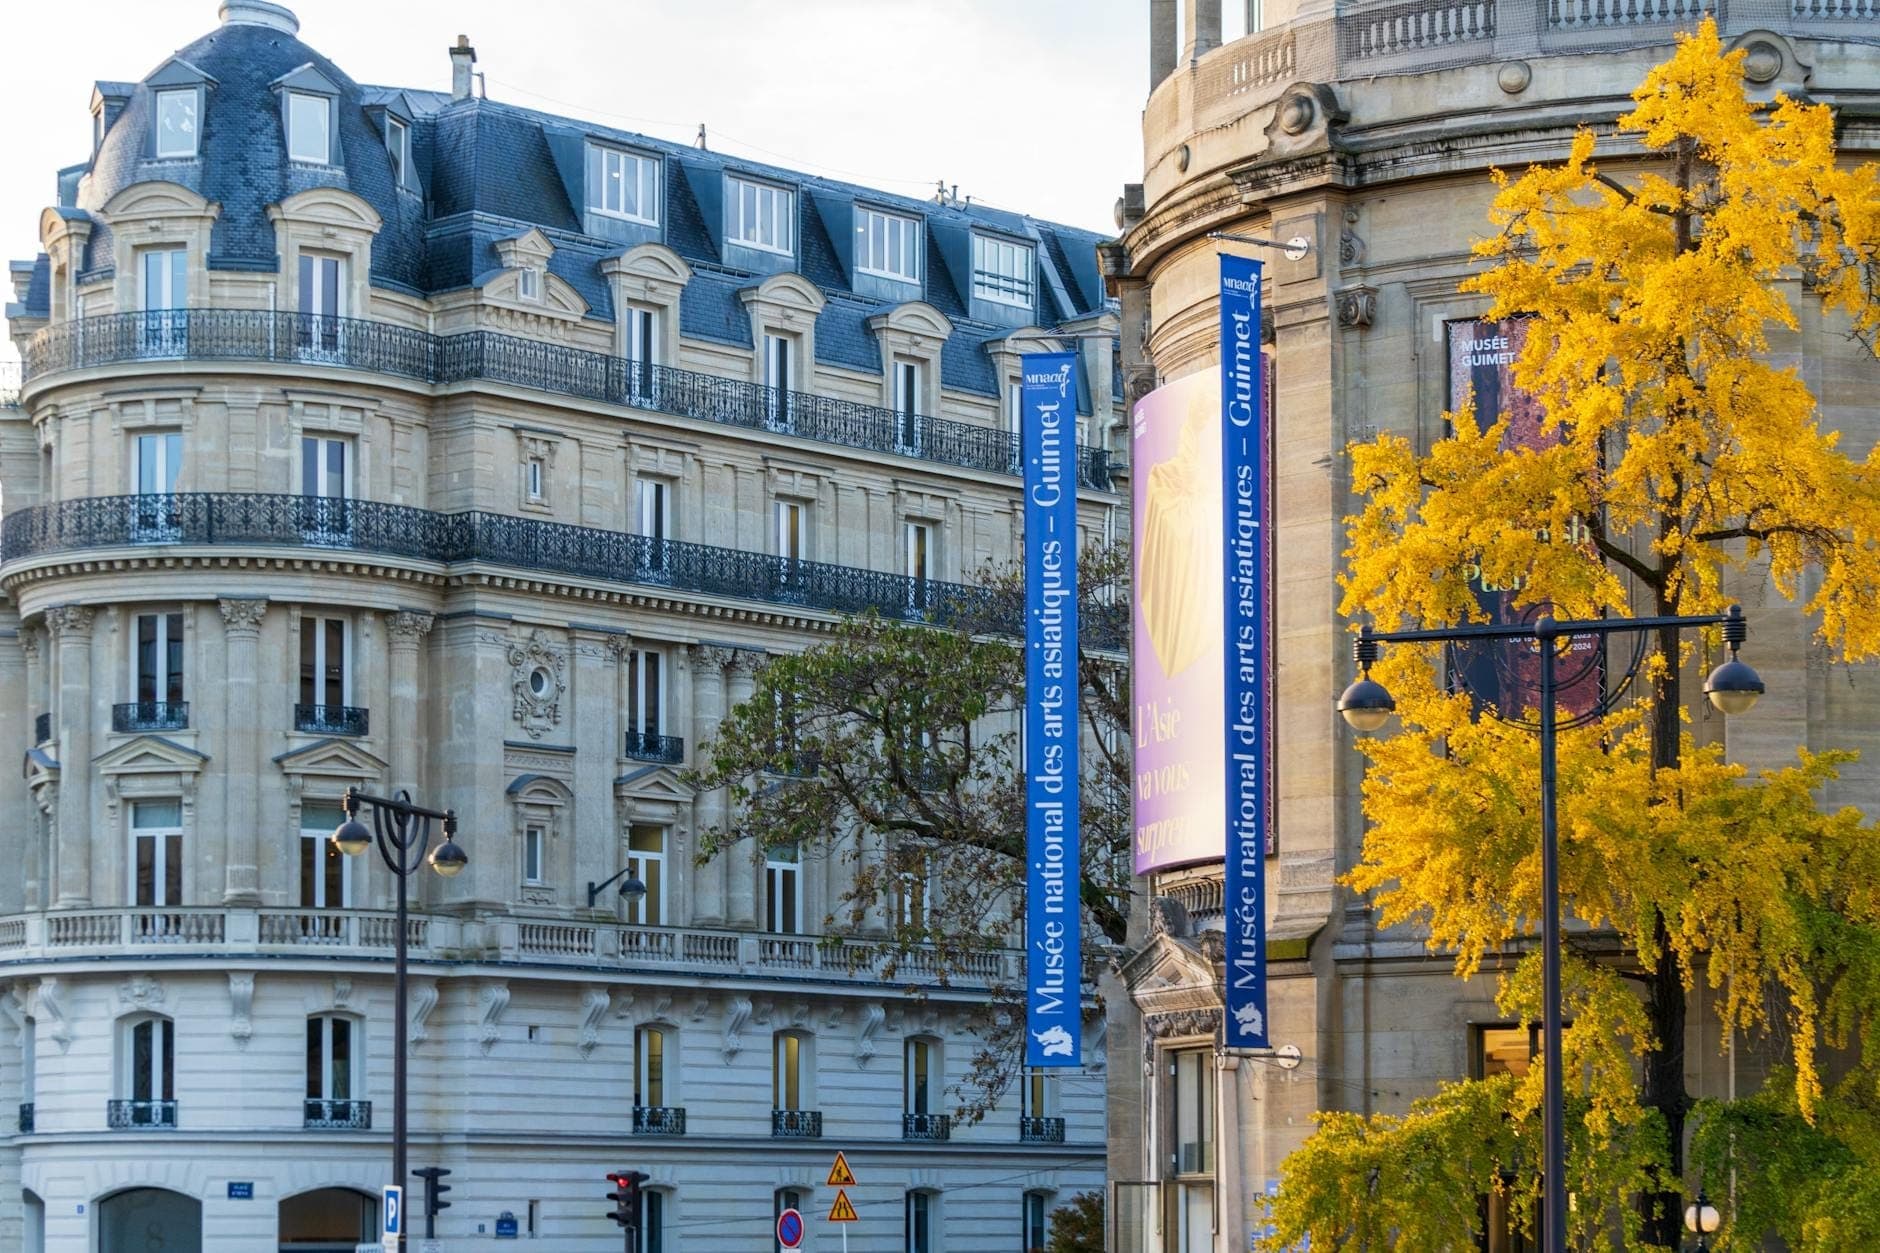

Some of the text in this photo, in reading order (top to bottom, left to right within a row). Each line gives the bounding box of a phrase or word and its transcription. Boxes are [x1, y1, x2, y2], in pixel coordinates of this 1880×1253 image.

[1228, 308, 1251, 427] Guimet
[1462, 336, 1509, 352] MUSÉE
[1462, 352, 1516, 367] GUIMET
[1032, 400, 1061, 508] Guimet
[1231, 465, 1260, 618] asiatiques
[1034, 540, 1070, 679] asiatiques
[1236, 625, 1255, 684] arts
[1573, 642, 1592, 651] 2024
[1039, 685, 1063, 738] arts
[1233, 691, 1256, 745] des
[1035, 744, 1064, 794] des
[1137, 760, 1192, 801] va vous
[1232, 753, 1256, 877] national
[1035, 801, 1064, 913] national
[1233, 886, 1256, 990] Musée
[1035, 921, 1065, 1015] Musée
[387, 1197, 397, 1228] P
